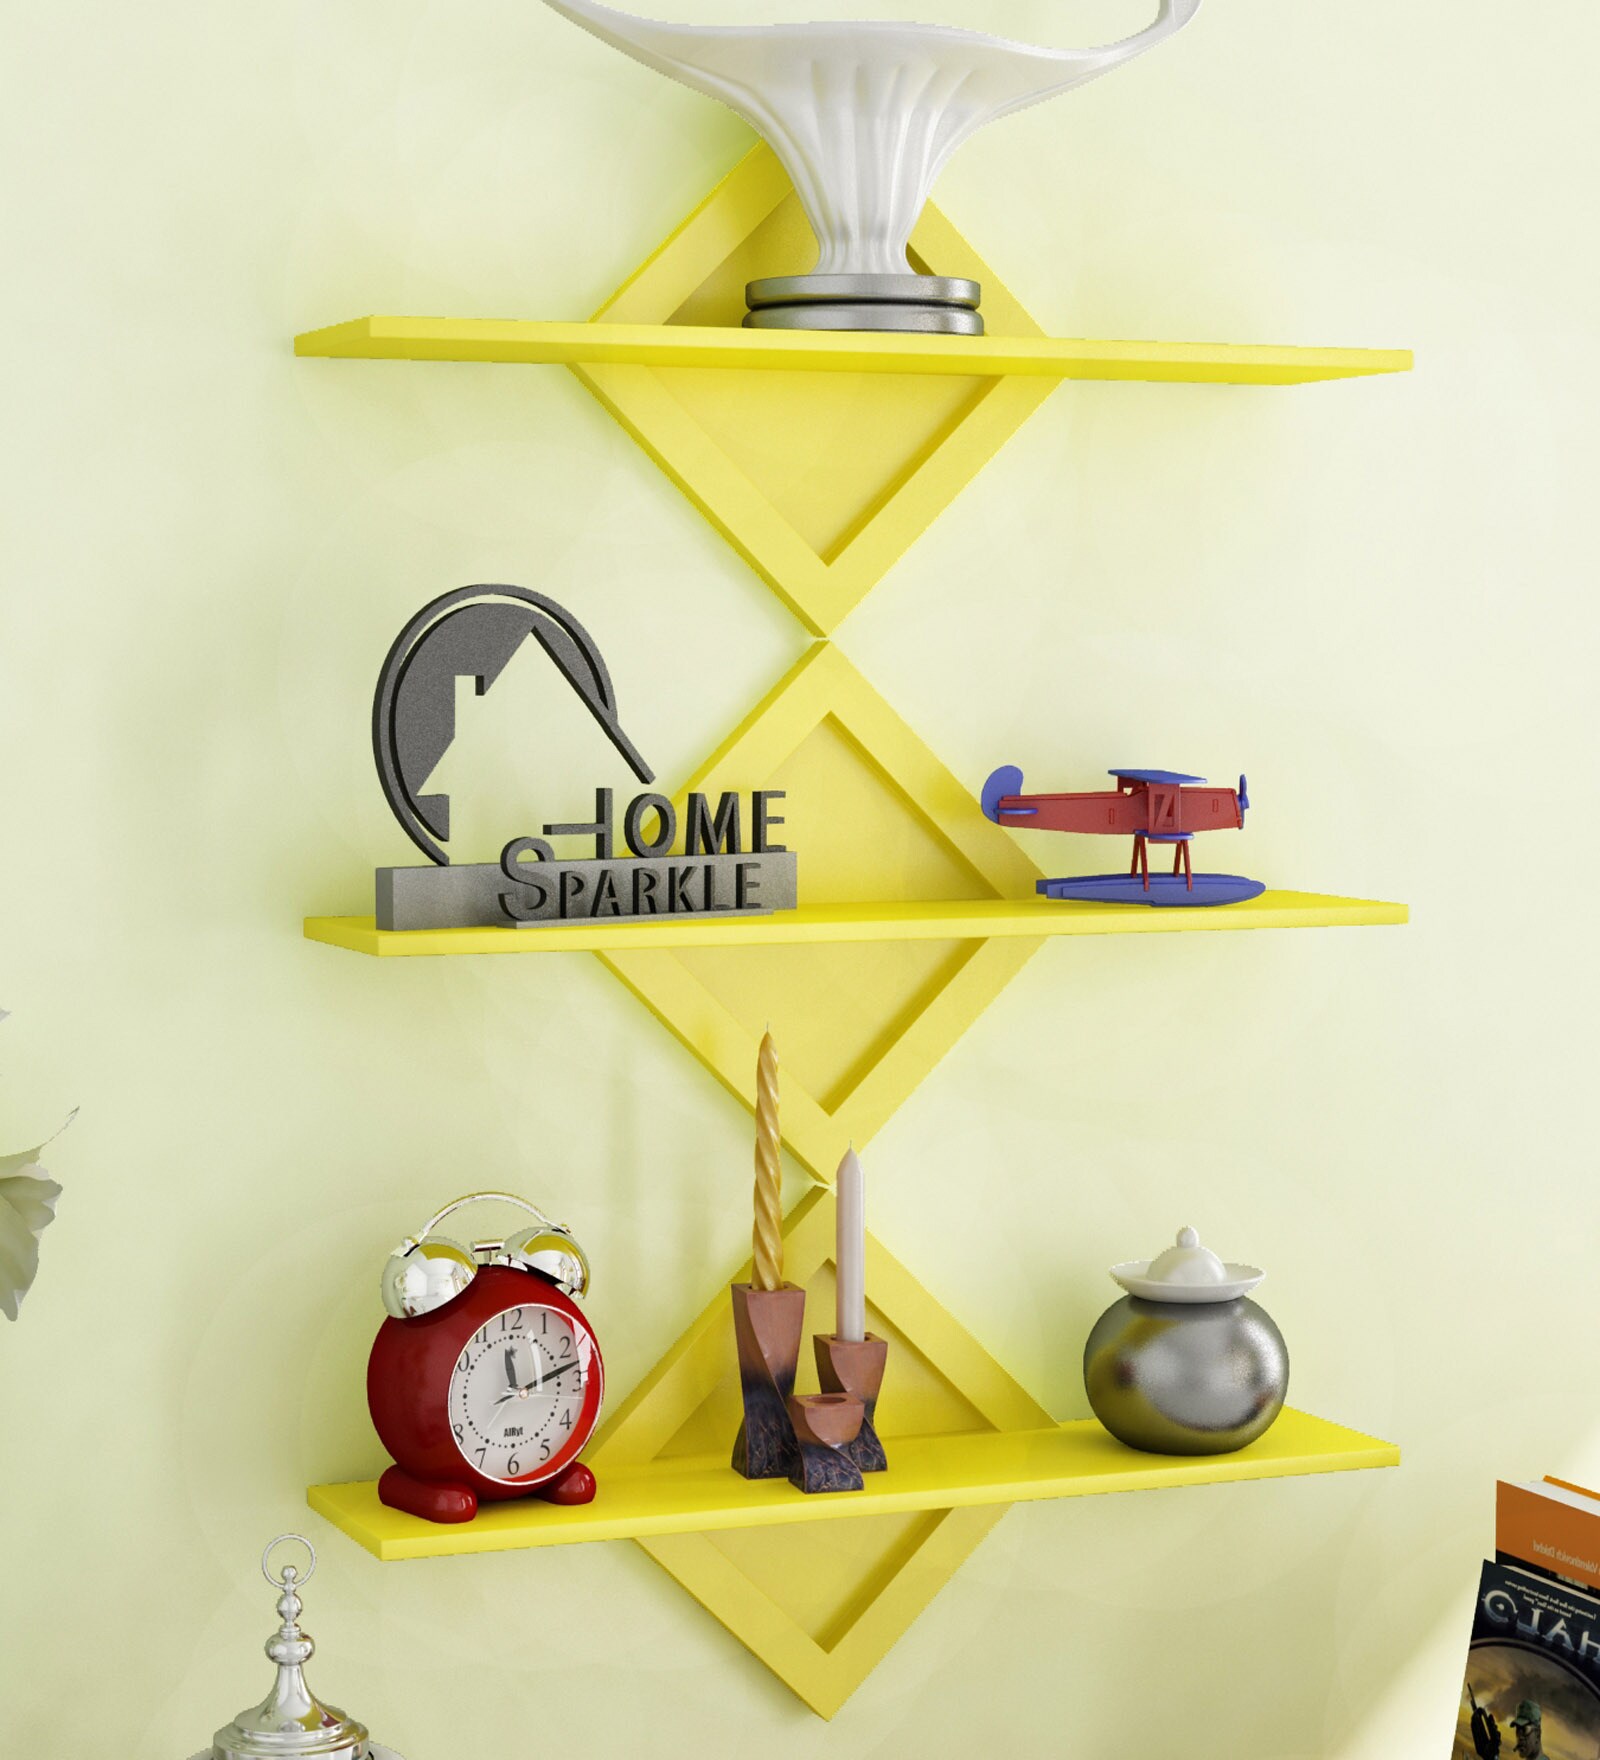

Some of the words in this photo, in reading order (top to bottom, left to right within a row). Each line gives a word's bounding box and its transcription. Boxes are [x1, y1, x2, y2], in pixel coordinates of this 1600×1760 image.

[543, 788, 787, 859] HOME
[498, 837, 762, 920] SPARKLE
[501, 1307, 524, 1332] 12
[541, 1312, 548, 1335] 1
[559, 1335, 572, 1359] 2
[559, 1408, 573, 1431] 4
[475, 1447, 487, 1470] 7
[539, 1438, 551, 1461] 5
[507, 1452, 520, 1476] 6
